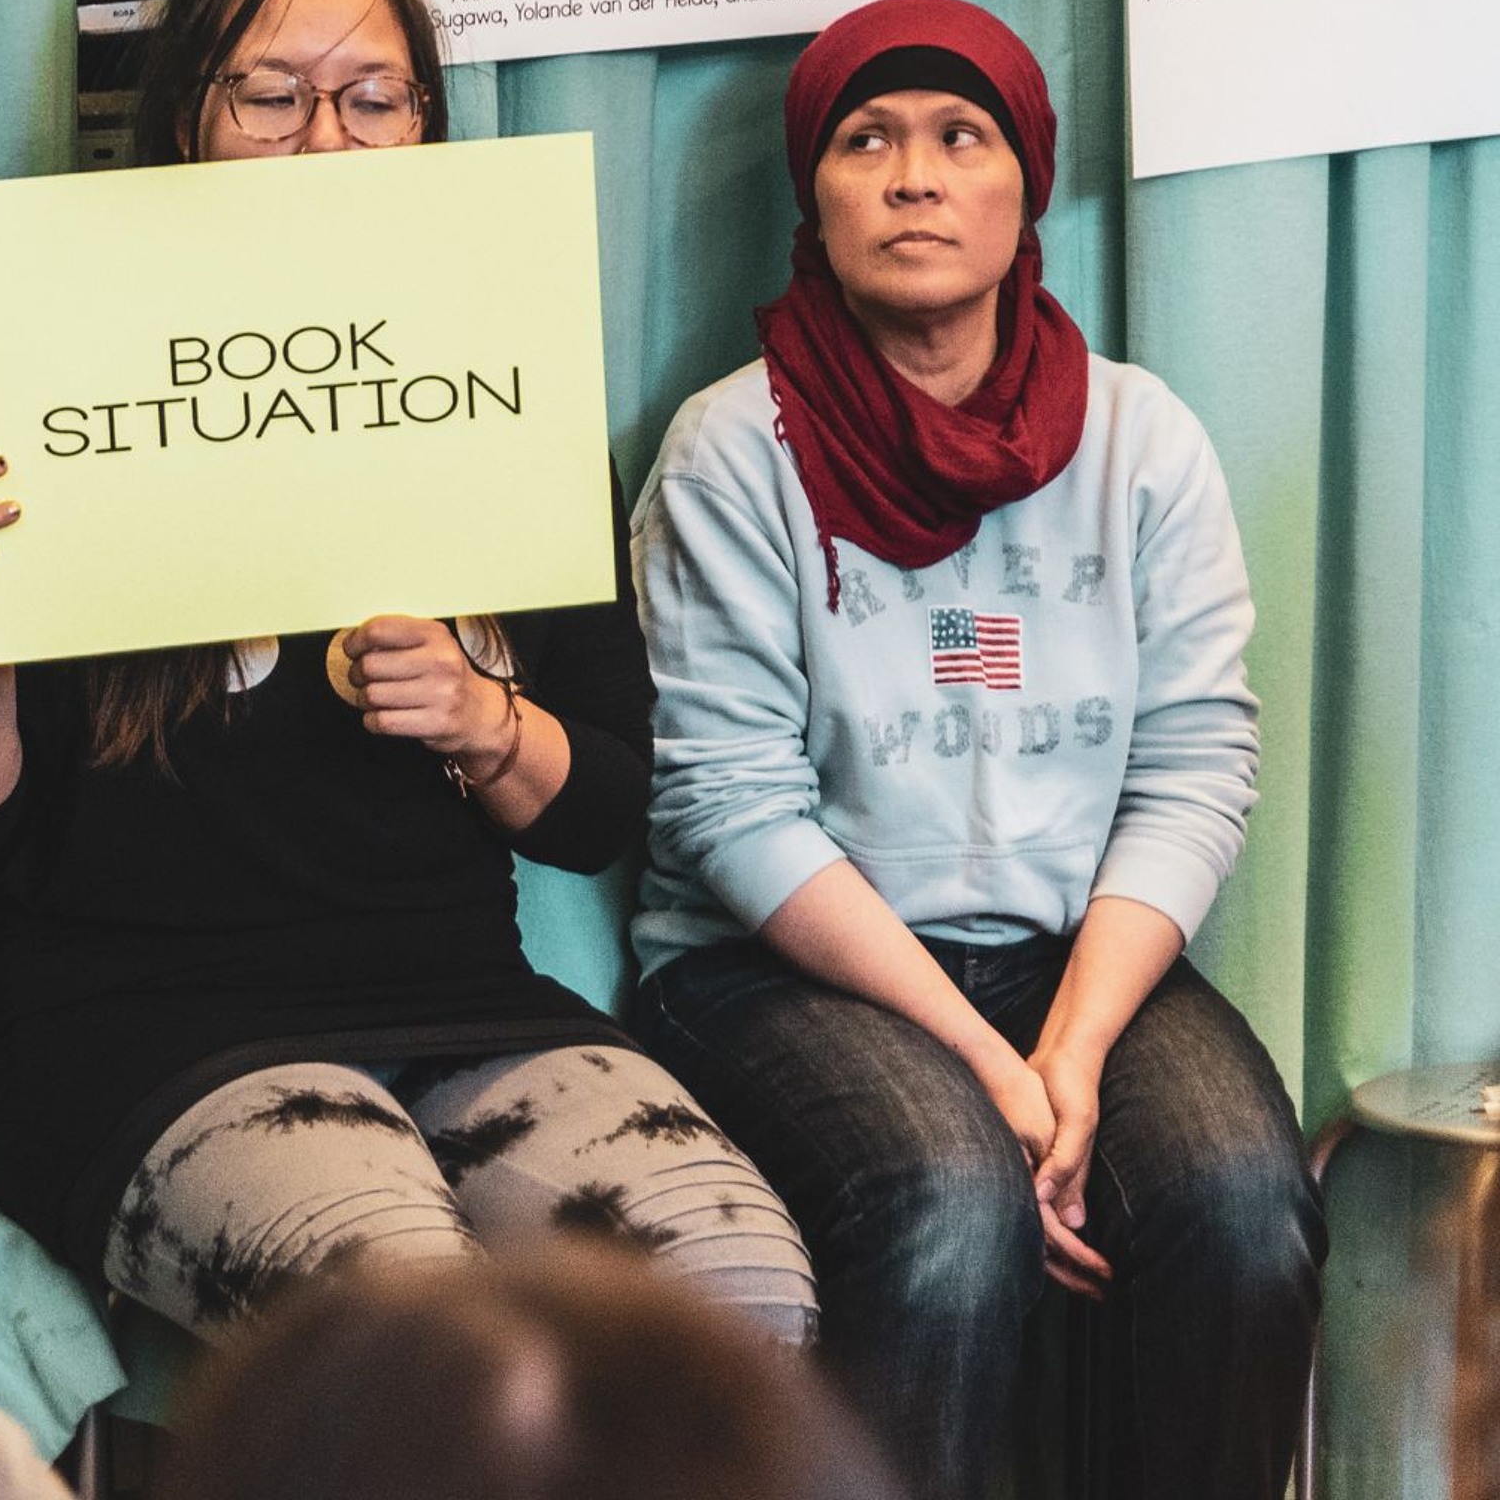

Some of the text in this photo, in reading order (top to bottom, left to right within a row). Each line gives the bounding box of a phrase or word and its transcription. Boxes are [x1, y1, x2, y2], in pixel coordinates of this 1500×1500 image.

[431, 9, 508, 40] Sugawa,
[590, 0, 622, 14] van
[169, 320, 395, 387] BOOK
[43, 366, 521, 457] SITUATION
